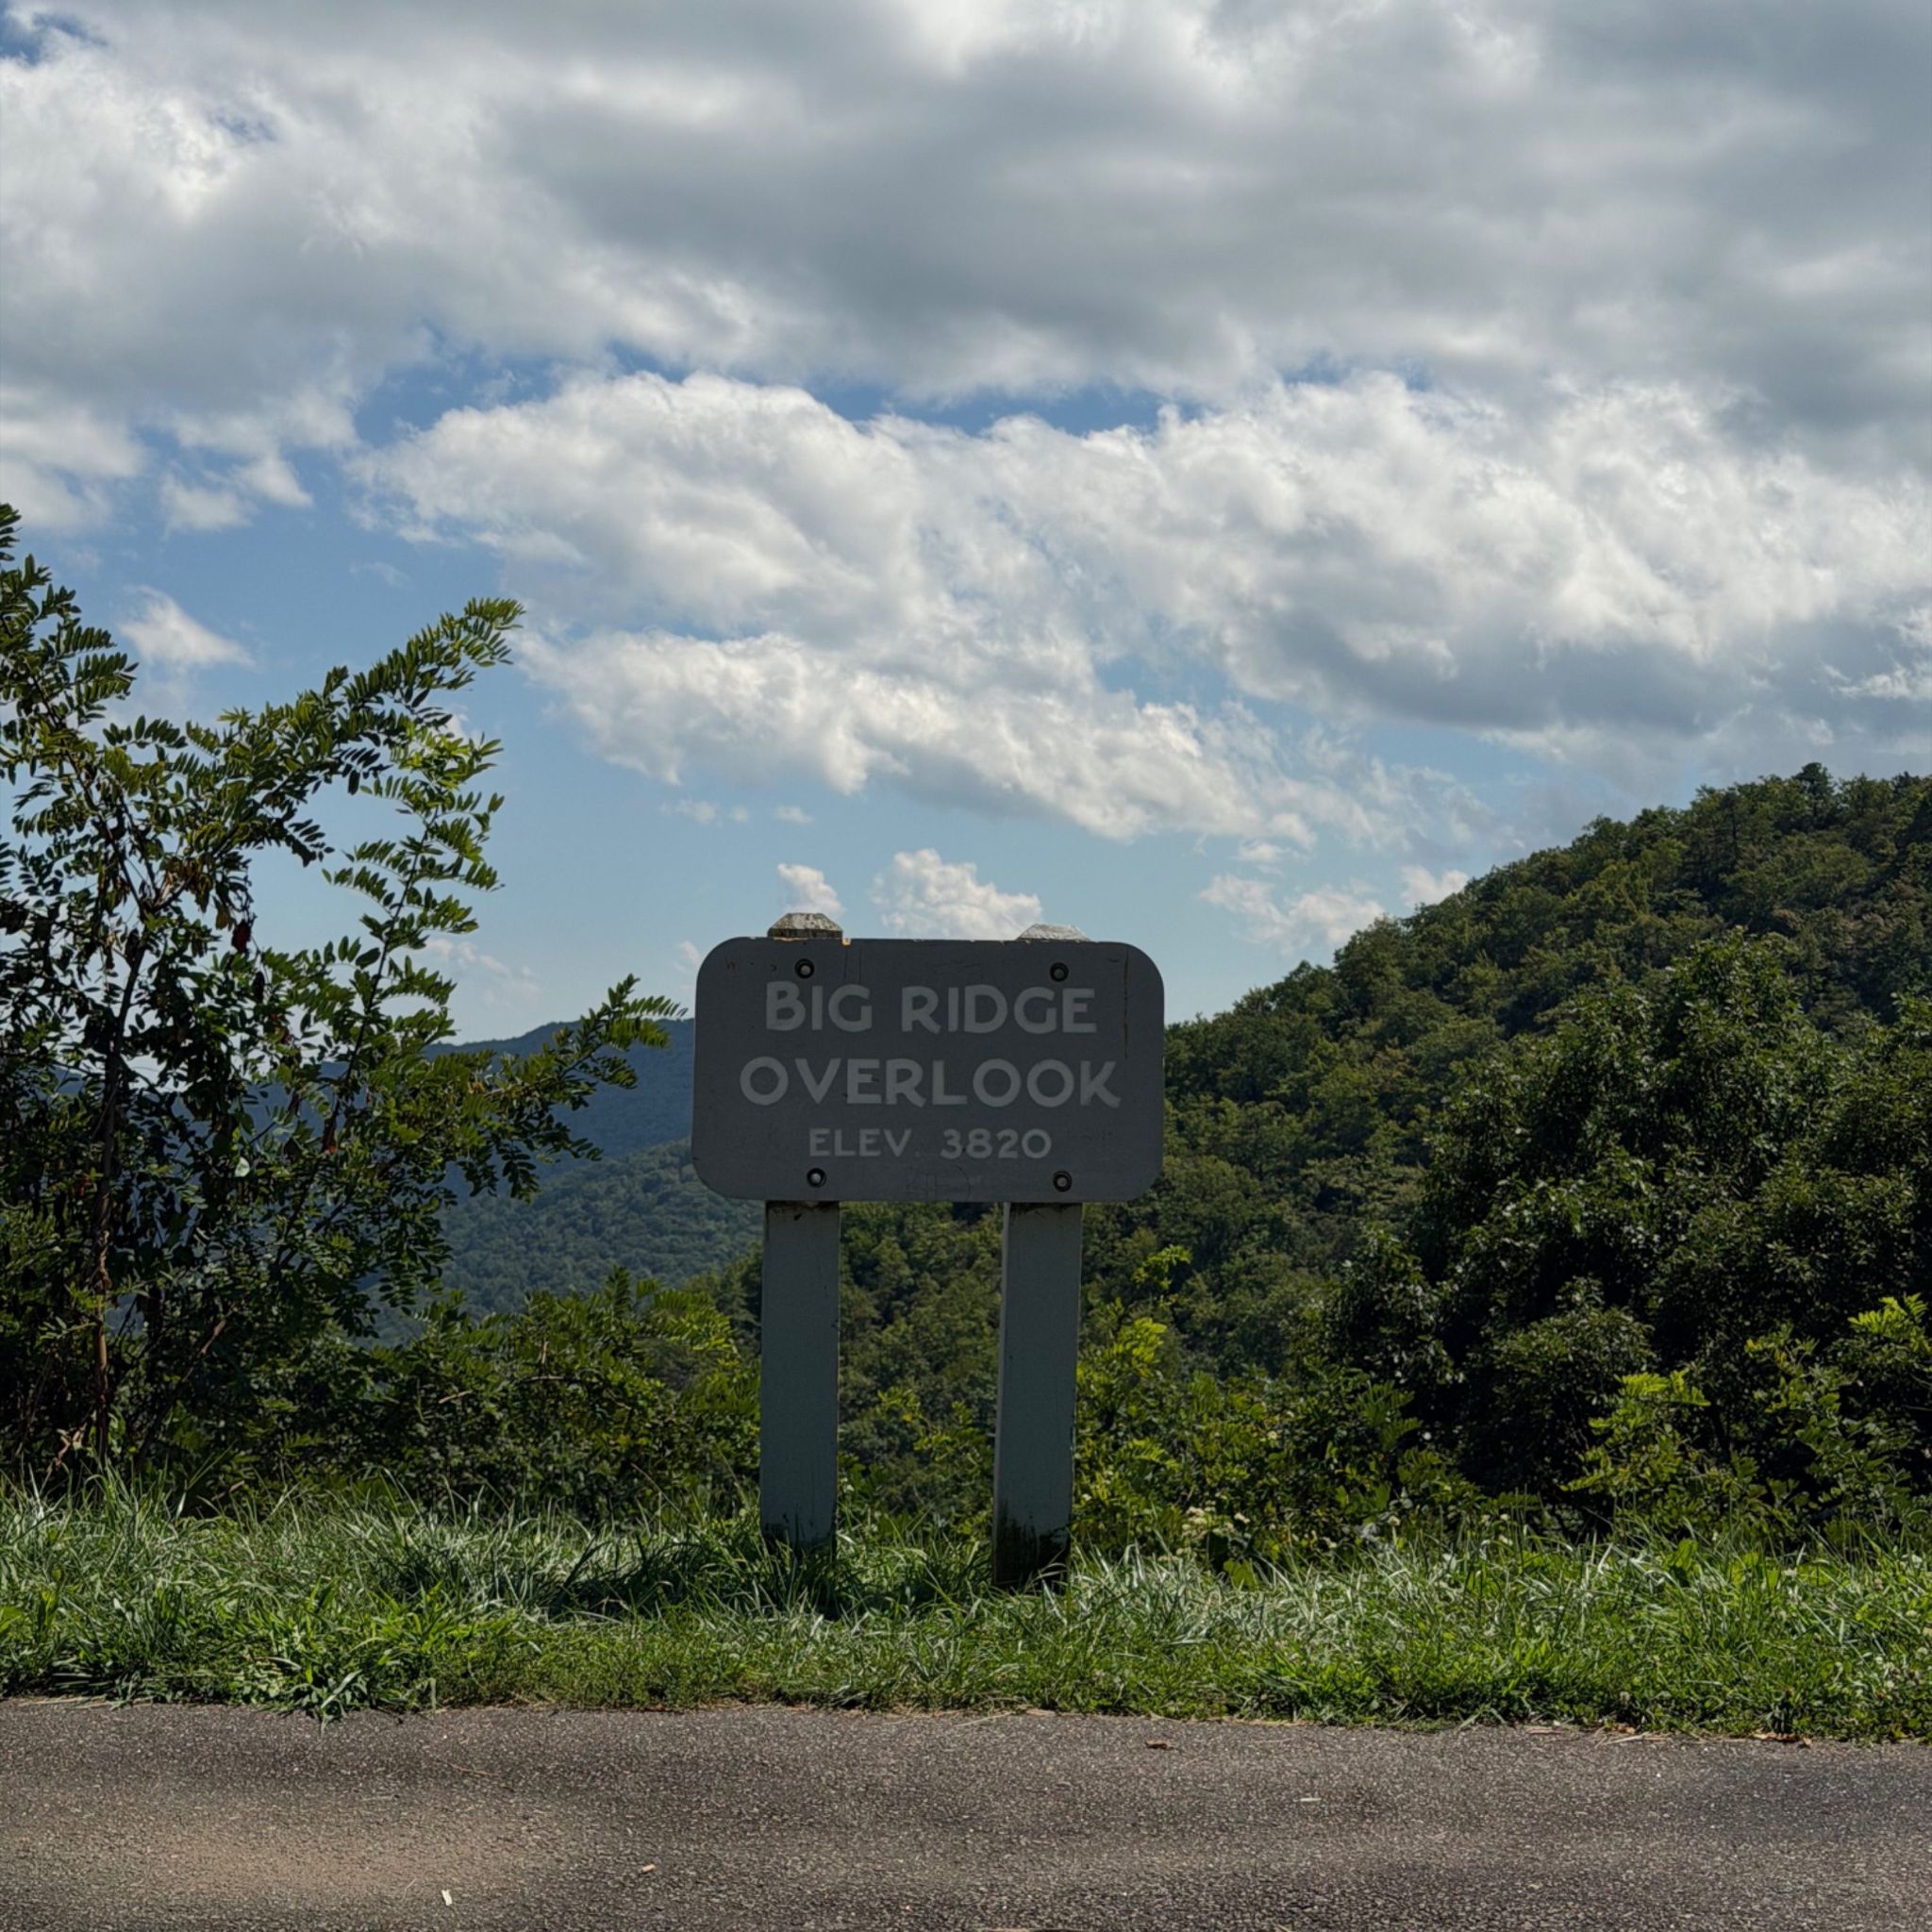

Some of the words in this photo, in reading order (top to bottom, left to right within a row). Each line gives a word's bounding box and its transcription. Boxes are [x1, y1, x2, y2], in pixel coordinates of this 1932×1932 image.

[765, 980, 873, 1033] BIG
[901, 984, 1097, 1035] RIDGE
[739, 1056, 1121, 1108] OVERLOOK
[808, 1127, 912, 1158] ELEV
[940, 1128, 1052, 1159] 3820
